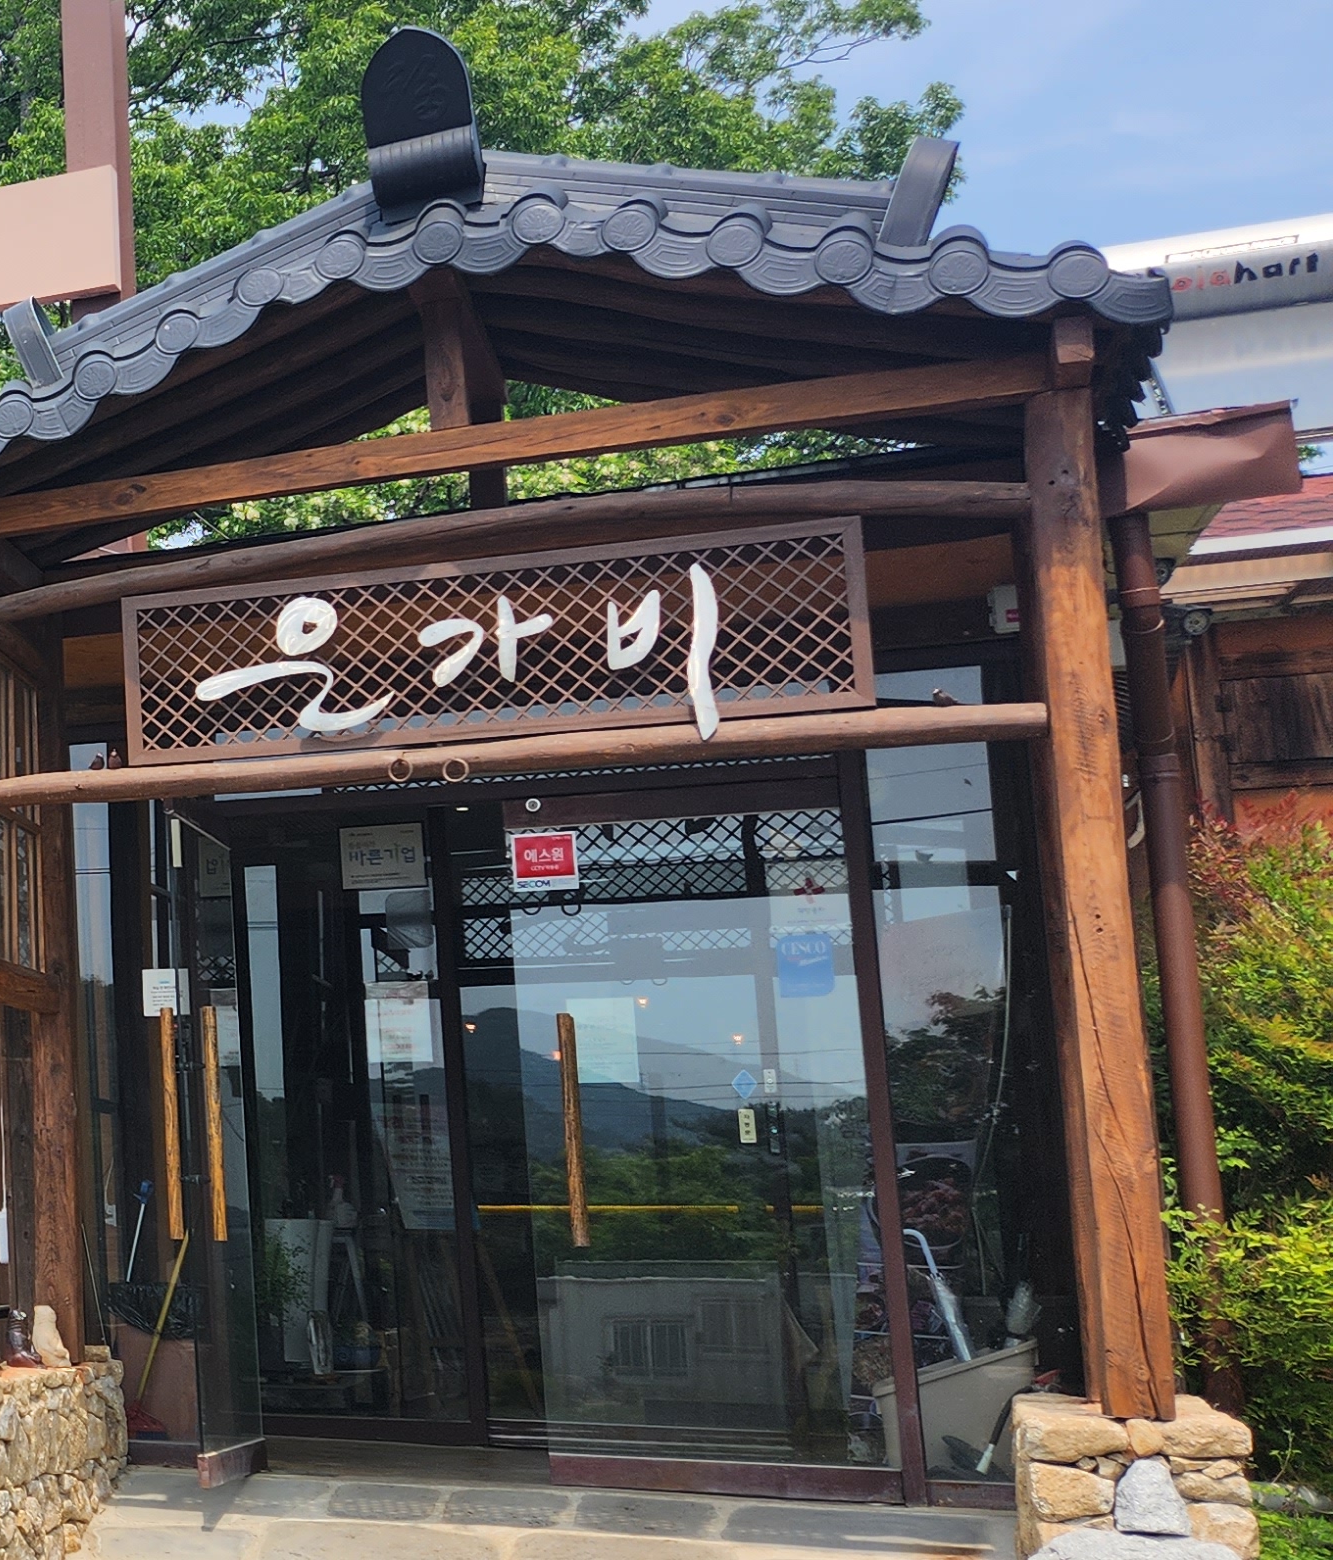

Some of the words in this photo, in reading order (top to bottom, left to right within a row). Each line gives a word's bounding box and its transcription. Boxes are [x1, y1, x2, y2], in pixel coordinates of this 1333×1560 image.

[1171, 253, 1319, 292] olahart
[195, 562, 720, 741] 은가비
[523, 847, 565, 862] 에스원
[516, 879, 551, 889] SECOM
[780, 940, 827, 955] CESCO
